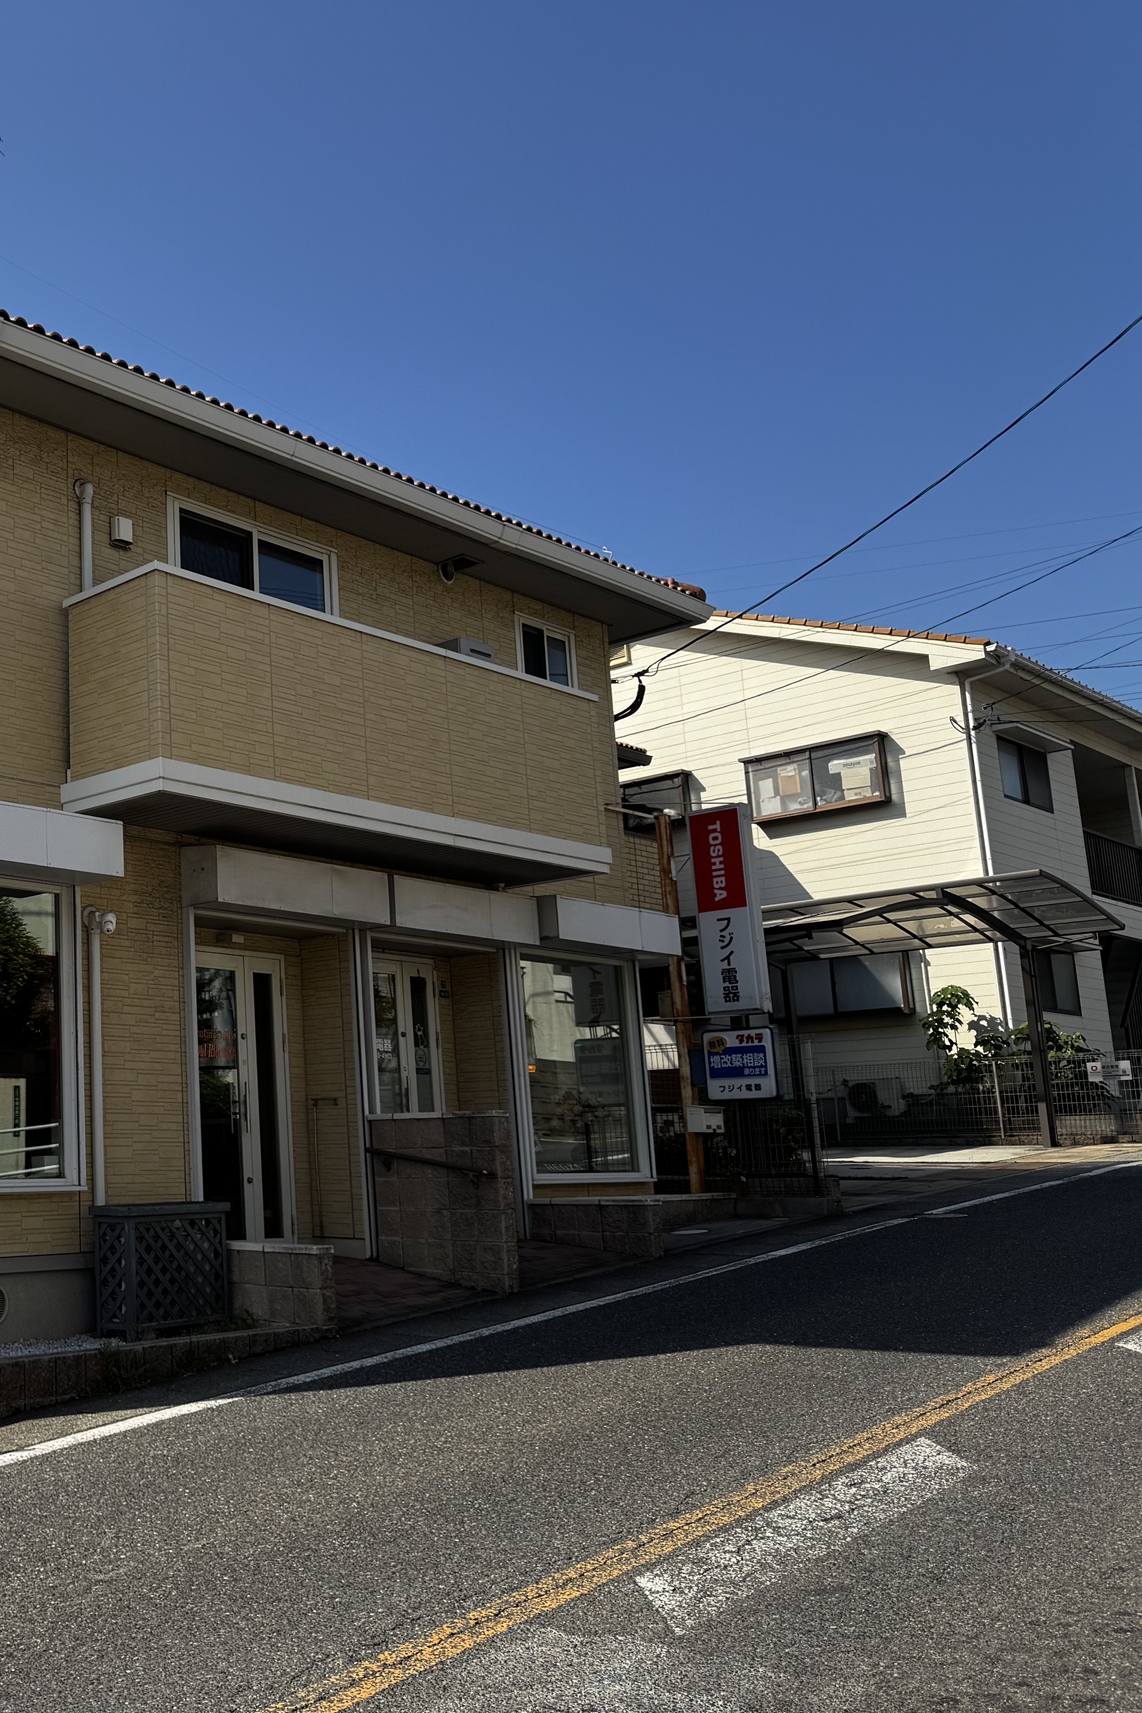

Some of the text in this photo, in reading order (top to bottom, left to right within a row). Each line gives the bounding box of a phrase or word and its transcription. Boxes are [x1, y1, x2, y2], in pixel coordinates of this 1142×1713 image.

[842, 760, 861, 768] amazon
[707, 820, 727, 902] TOSHIBA
[716, 917, 741, 1003] フジイ電器
[736, 1032, 764, 1044] タカラ
[710, 1052, 766, 1069] 増改築相談
[743, 1067, 767, 1076] 承ります
[718, 1083, 762, 1093] フジイ電器
